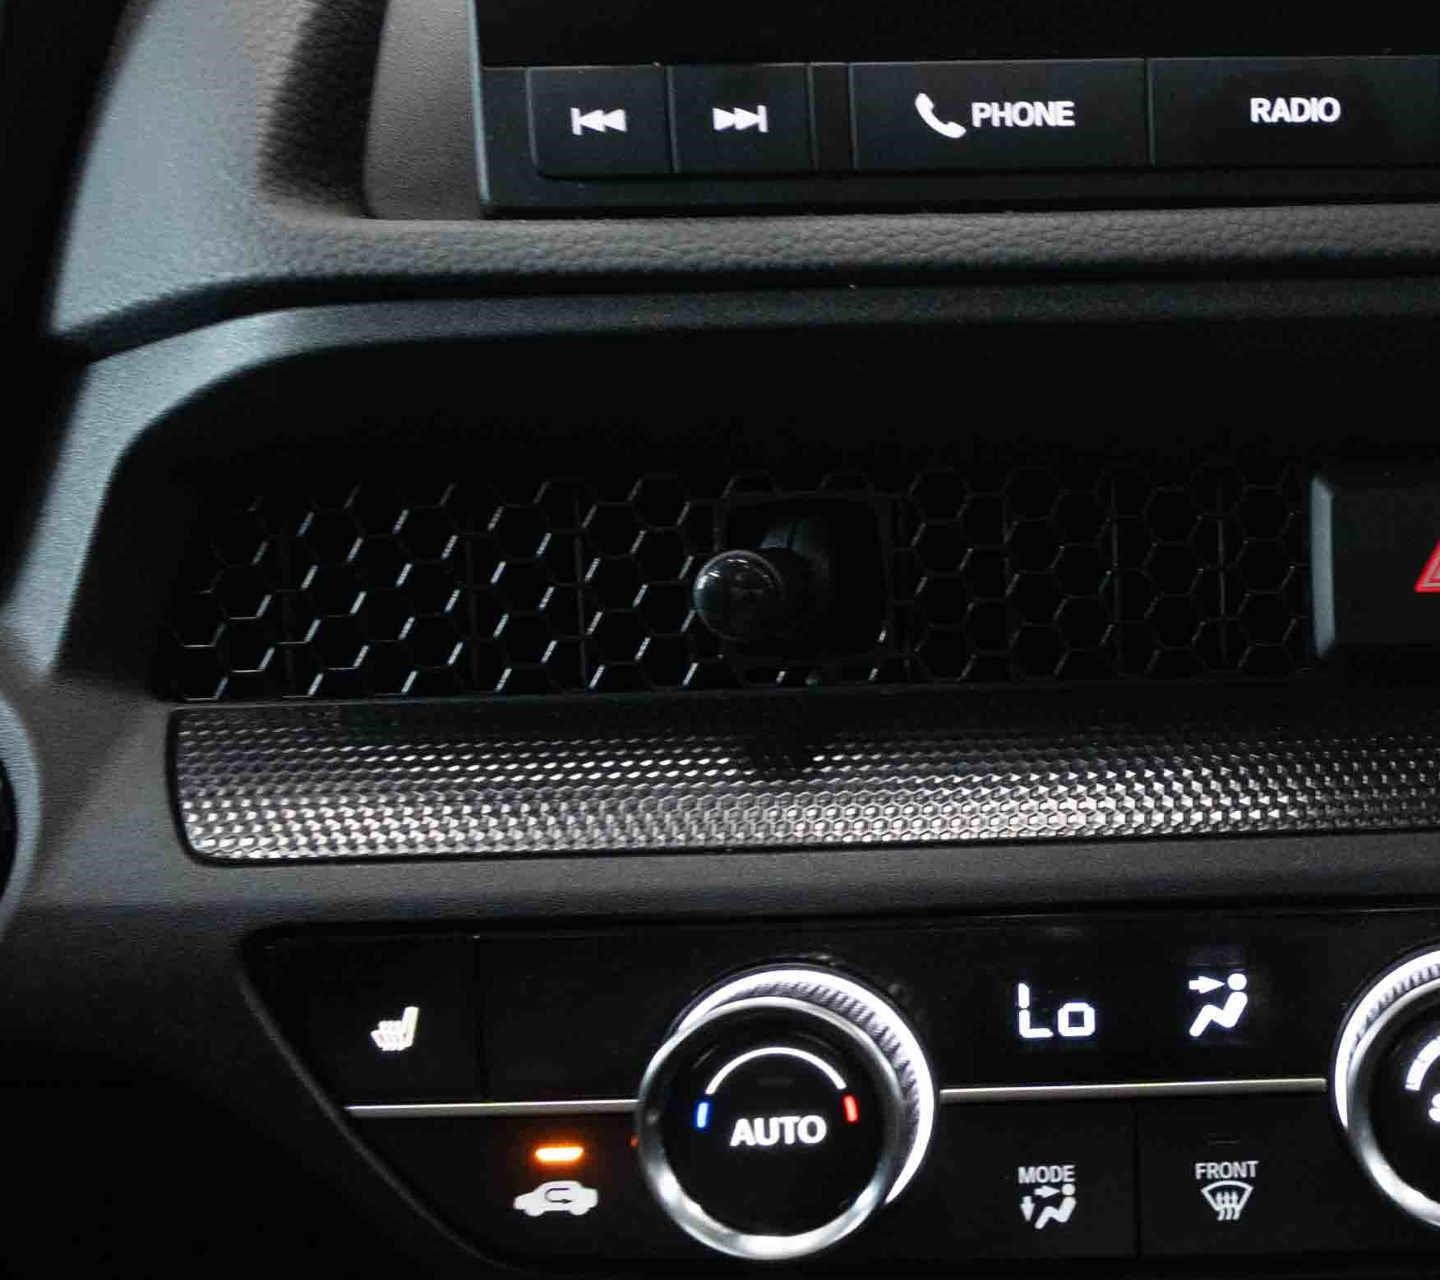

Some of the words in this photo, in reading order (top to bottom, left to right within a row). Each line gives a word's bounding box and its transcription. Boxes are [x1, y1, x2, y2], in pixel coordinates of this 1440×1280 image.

[971, 100, 1076, 128] PHONE
[1250, 96, 1342, 123] RADIO
[729, 1114, 828, 1147] AUTO
[1017, 1165, 1077, 1185] MODE
[1194, 1160, 1259, 1180] FRONT
